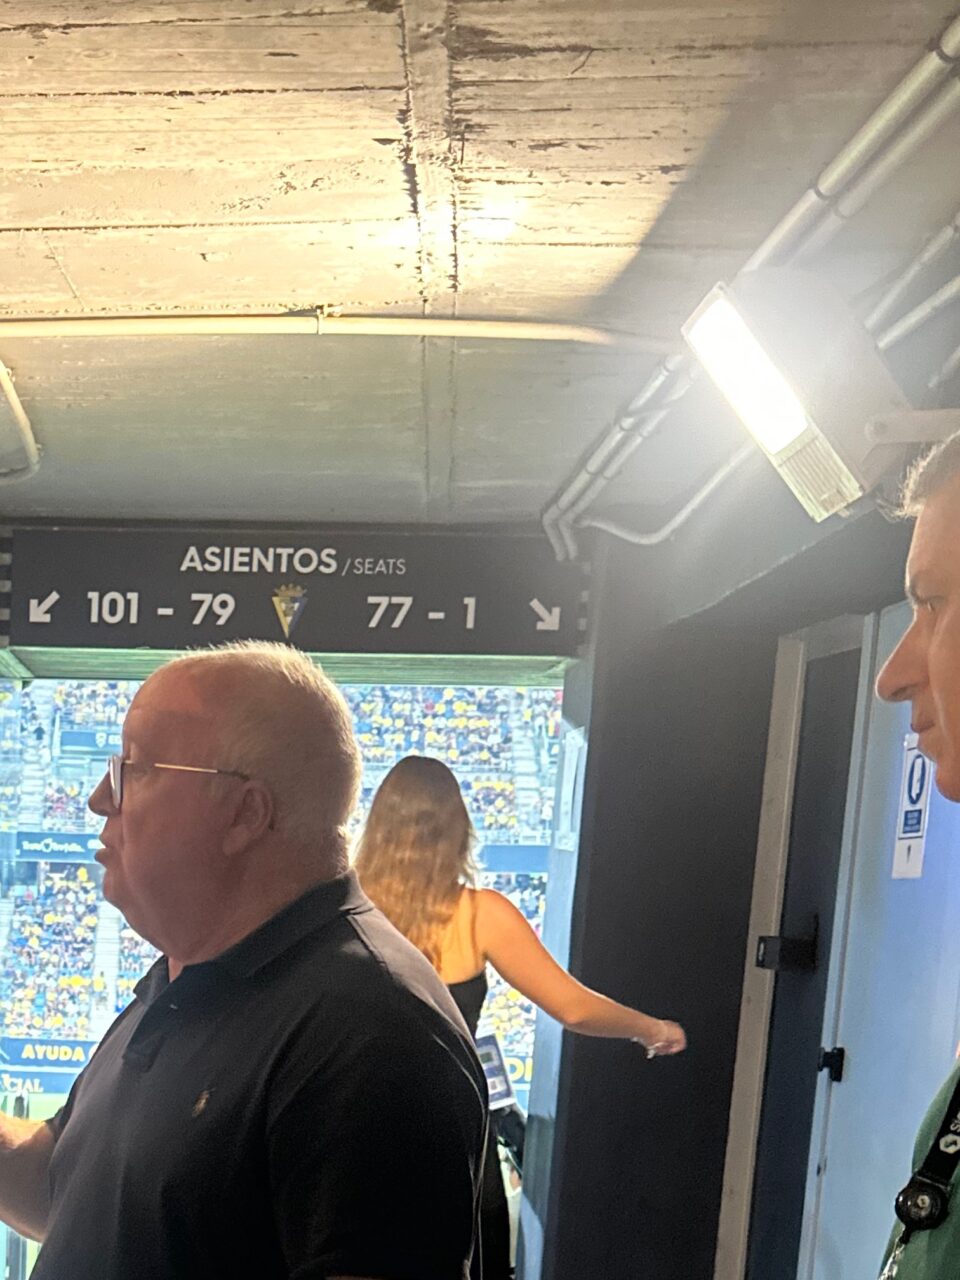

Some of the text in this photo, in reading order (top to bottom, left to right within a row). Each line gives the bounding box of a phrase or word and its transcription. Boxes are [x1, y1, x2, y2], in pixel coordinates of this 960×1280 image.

[179, 545, 339, 575] ASIENTOS
[86, 590, 139, 624] 101
[190, 592, 236, 626] 79
[366, 595, 414, 628] 77
[463, 596, 476, 629] 1
[21, 1044, 85, 1061] AYUDA
